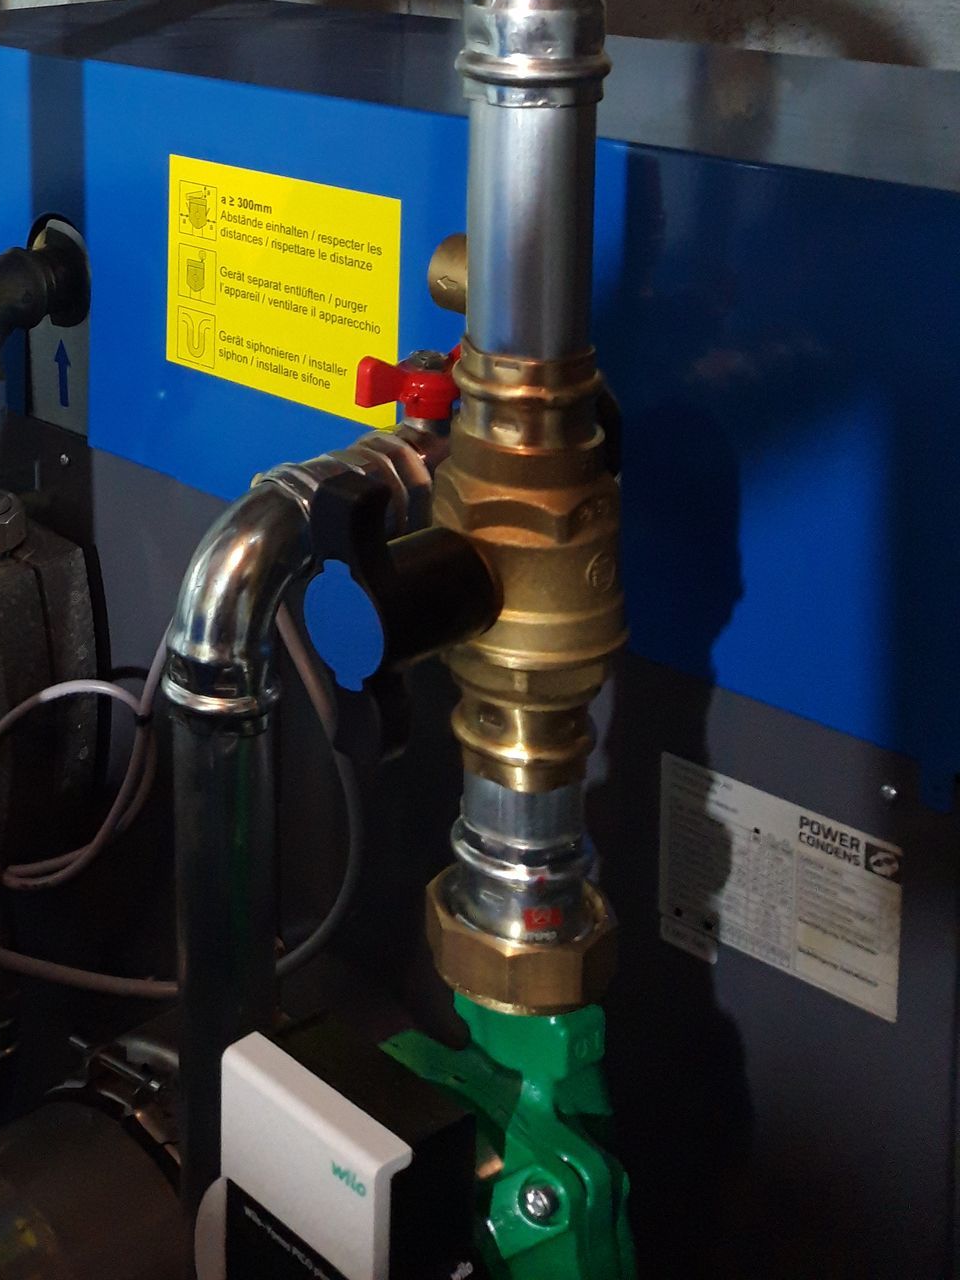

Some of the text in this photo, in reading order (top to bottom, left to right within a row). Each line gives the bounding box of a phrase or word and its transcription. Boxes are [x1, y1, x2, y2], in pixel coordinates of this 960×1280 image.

[221, 196, 227, 205] a
[237, 197, 273, 214] 300mm
[220, 210, 383, 256] Abstände einhalten / respecter les
[220, 227, 373, 271] distances / rispettare le distanze
[219, 282, 381, 335] l'appareil / ventilare il apparecchio
[220, 266, 368, 313] Gerät separat entlüften / purger
[218, 347, 331, 389] siphon / installare sifone
[219, 330, 348, 377] Gerät siphonieren / installer
[798, 831, 861, 867] CONDENS
[799, 815, 860, 853] POWER
[331, 1160, 367, 1198] wilo
